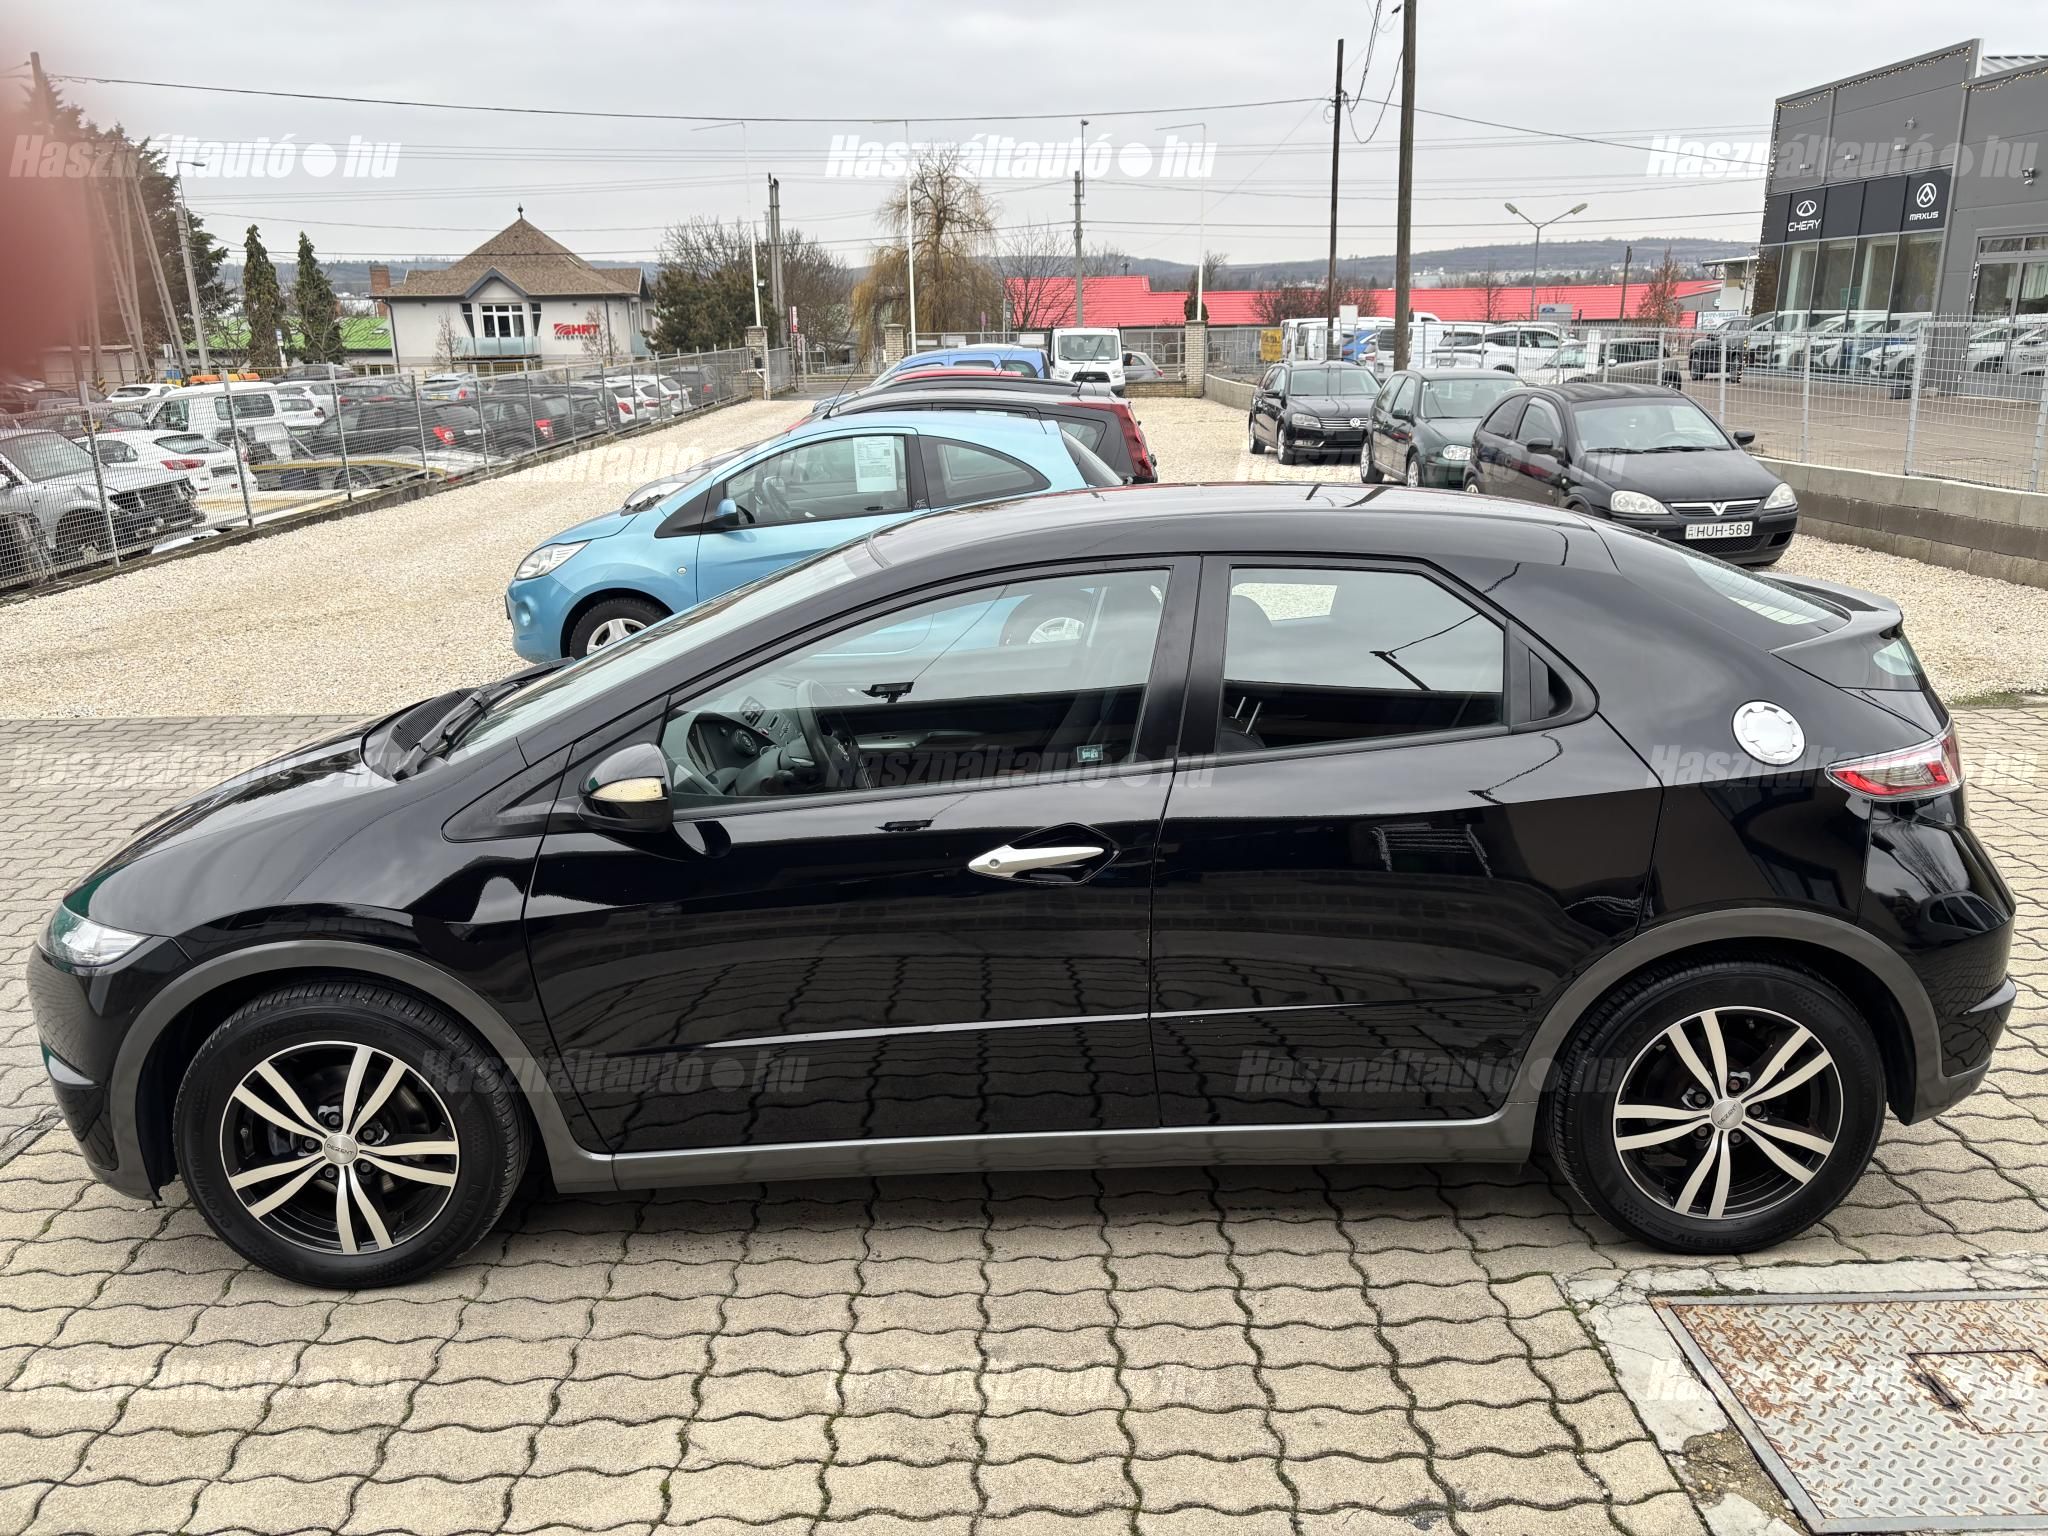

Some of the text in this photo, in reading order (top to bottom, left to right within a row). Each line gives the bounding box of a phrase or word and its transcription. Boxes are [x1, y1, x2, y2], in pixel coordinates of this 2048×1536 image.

[1909, 211, 1939, 222] MAXUS
[1787, 219, 1822, 232] CHERY
[1696, 523, 1751, 537] HUH-569
